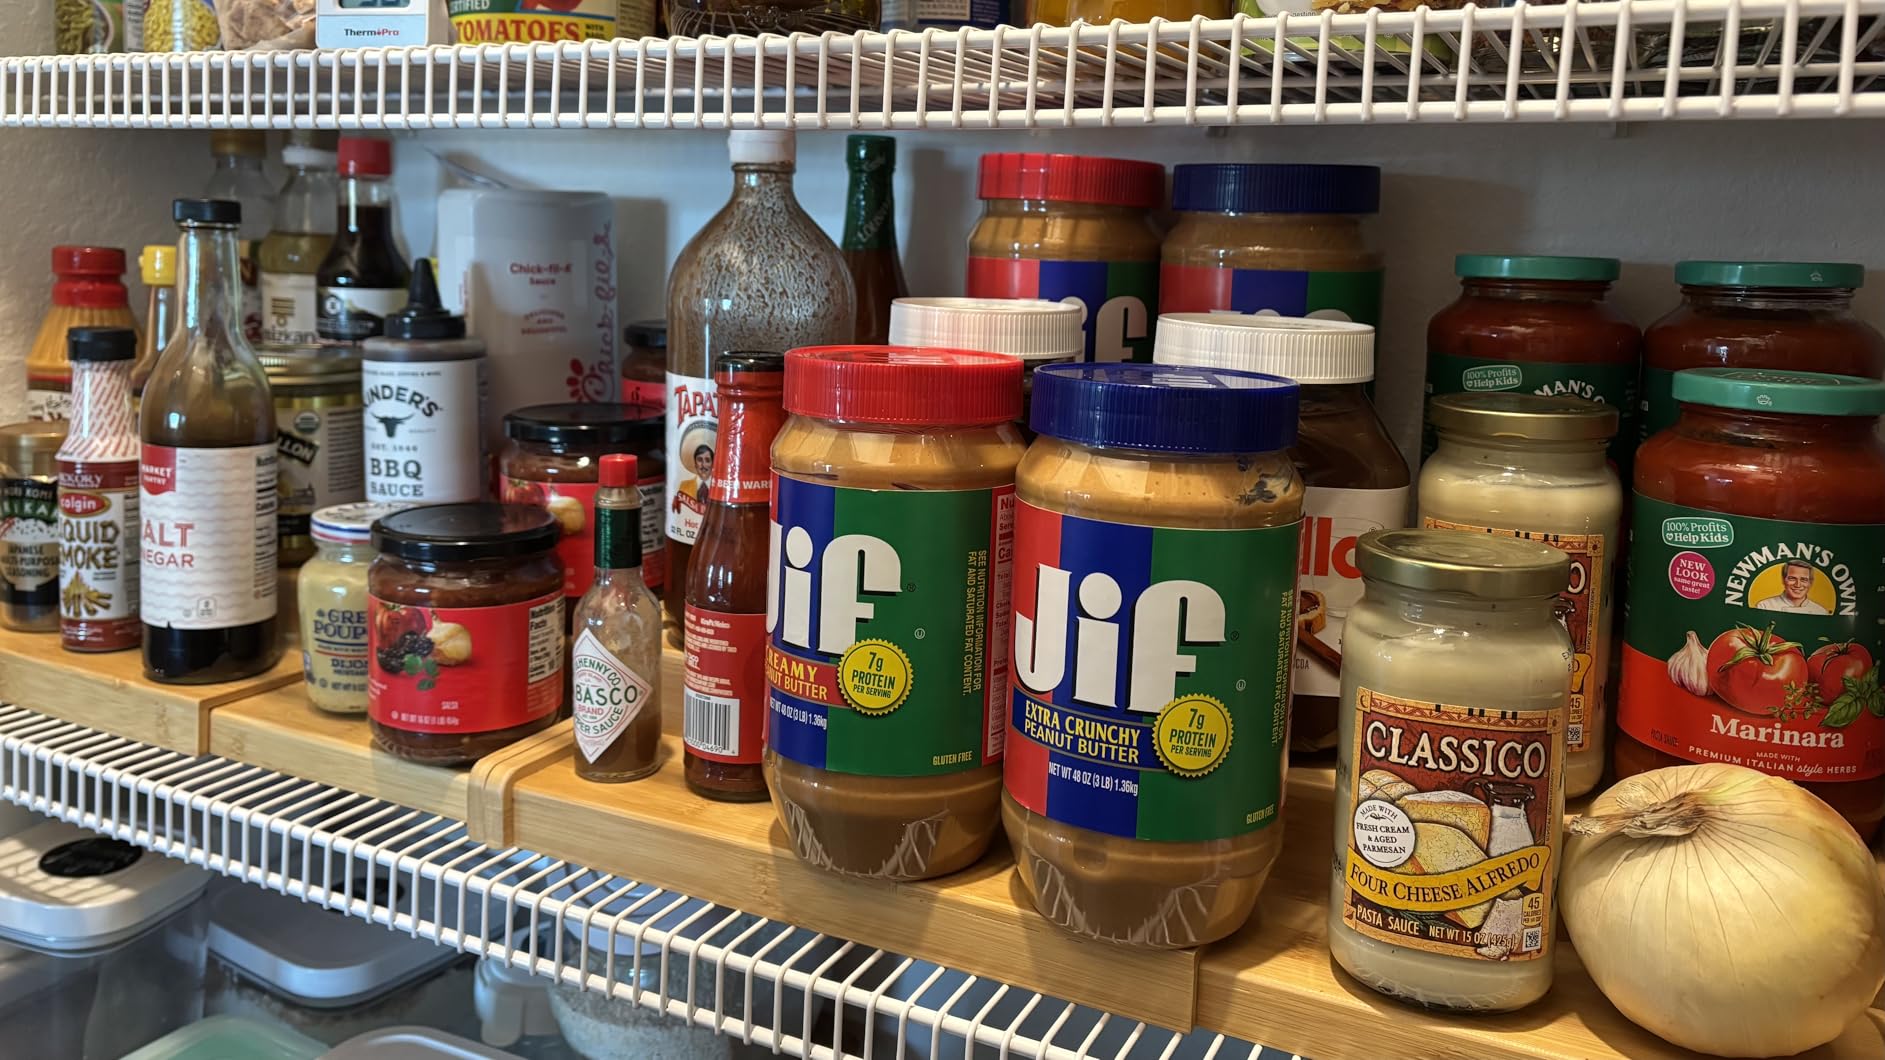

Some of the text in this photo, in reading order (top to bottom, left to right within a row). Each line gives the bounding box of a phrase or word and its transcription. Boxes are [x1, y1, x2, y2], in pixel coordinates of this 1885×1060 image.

[455, 19, 580, 42] TOMATOES
[1466, 367, 1518, 379] 100% Profits
[1473, 376, 1519, 388] Help Kids
[1534, 379, 1595, 399] MAN'S
[364, 384, 438, 418] INDER'S
[675, 385, 720, 429] TAPA
[371, 458, 423, 481] BBQ
[371, 482, 424, 497] SAUCE
[743, 481, 772, 489] WAR
[63, 520, 119, 544] QUID
[143, 519, 194, 548] ALT
[1666, 521, 1728, 533] 100% Profits
[1674, 532, 1730, 545] Help Kids
[142, 549, 194, 568] EGAR
[1679, 558, 1707, 572] NEW
[1673, 576, 1711, 590] same great
[1675, 567, 1710, 582] LOOK
[1724, 542, 1834, 607] NEWMAN'S
[1831, 564, 1859, 617] OWN
[766, 519, 903, 656] Jif
[1681, 585, 1701, 595] taste!
[1280, 592, 1288, 607] FAT
[328, 609, 368, 624] GRE
[962, 551, 977, 696] FAT AND SATURATED FAT CONTENT.
[972, 549, 987, 691] SEE NUTRITION INFORMATION FOR
[1279, 610, 1287, 629] AND
[314, 619, 367, 640] POUP
[1015, 563, 1226, 715] Jif
[575, 658, 611, 675] LHENNY
[867, 651, 884, 673] 7g
[1275, 631, 1285, 683] SATURATED
[1296, 658, 1310, 671] COA
[784, 676, 828, 700] BUTTER
[852, 669, 896, 690] PROTEIN
[575, 684, 638, 706] BASCO
[853, 685, 892, 699] PER SERVING
[1274, 685, 1282, 700] FAT
[577, 704, 604, 716] BRAND
[1189, 708, 1205, 730] 7g
[592, 707, 624, 734] SAUCE
[808, 712, 828, 730] 1.36kg
[1025, 700, 1141, 747] EXTRA CRUNCHY
[1169, 729, 1217, 749] PROTEIN
[1710, 714, 1845, 749] Marinara
[1024, 722, 1140, 765] PEANUT BUTTER
[1170, 743, 1212, 758] PER SERVING
[1366, 721, 1546, 778] CLASSICO
[933, 751, 972, 766] GLUTEN FREE
[1688, 745, 1857, 777] PREMIUM ITALIAN style HERBS
[1756, 751, 1801, 762] MADE WITH
[1048, 761, 1139, 797] NET WT 48 OZ (3 LB) 1.36kg
[1247, 804, 1274, 824] GLUTEN FREE
[1360, 804, 1398, 819] MADE WITH
[1356, 822, 1411, 834] FRESH CREAM
[1363, 844, 1407, 855] PARMESAN
[1373, 835, 1398, 844] AGED
[1350, 852, 1540, 902] FOUR CHEESE ALFREDO
[1527, 896, 1540, 910] 45
[1357, 904, 1517, 950] PASTA SAUCE NET WT 15 OZ (425g)
